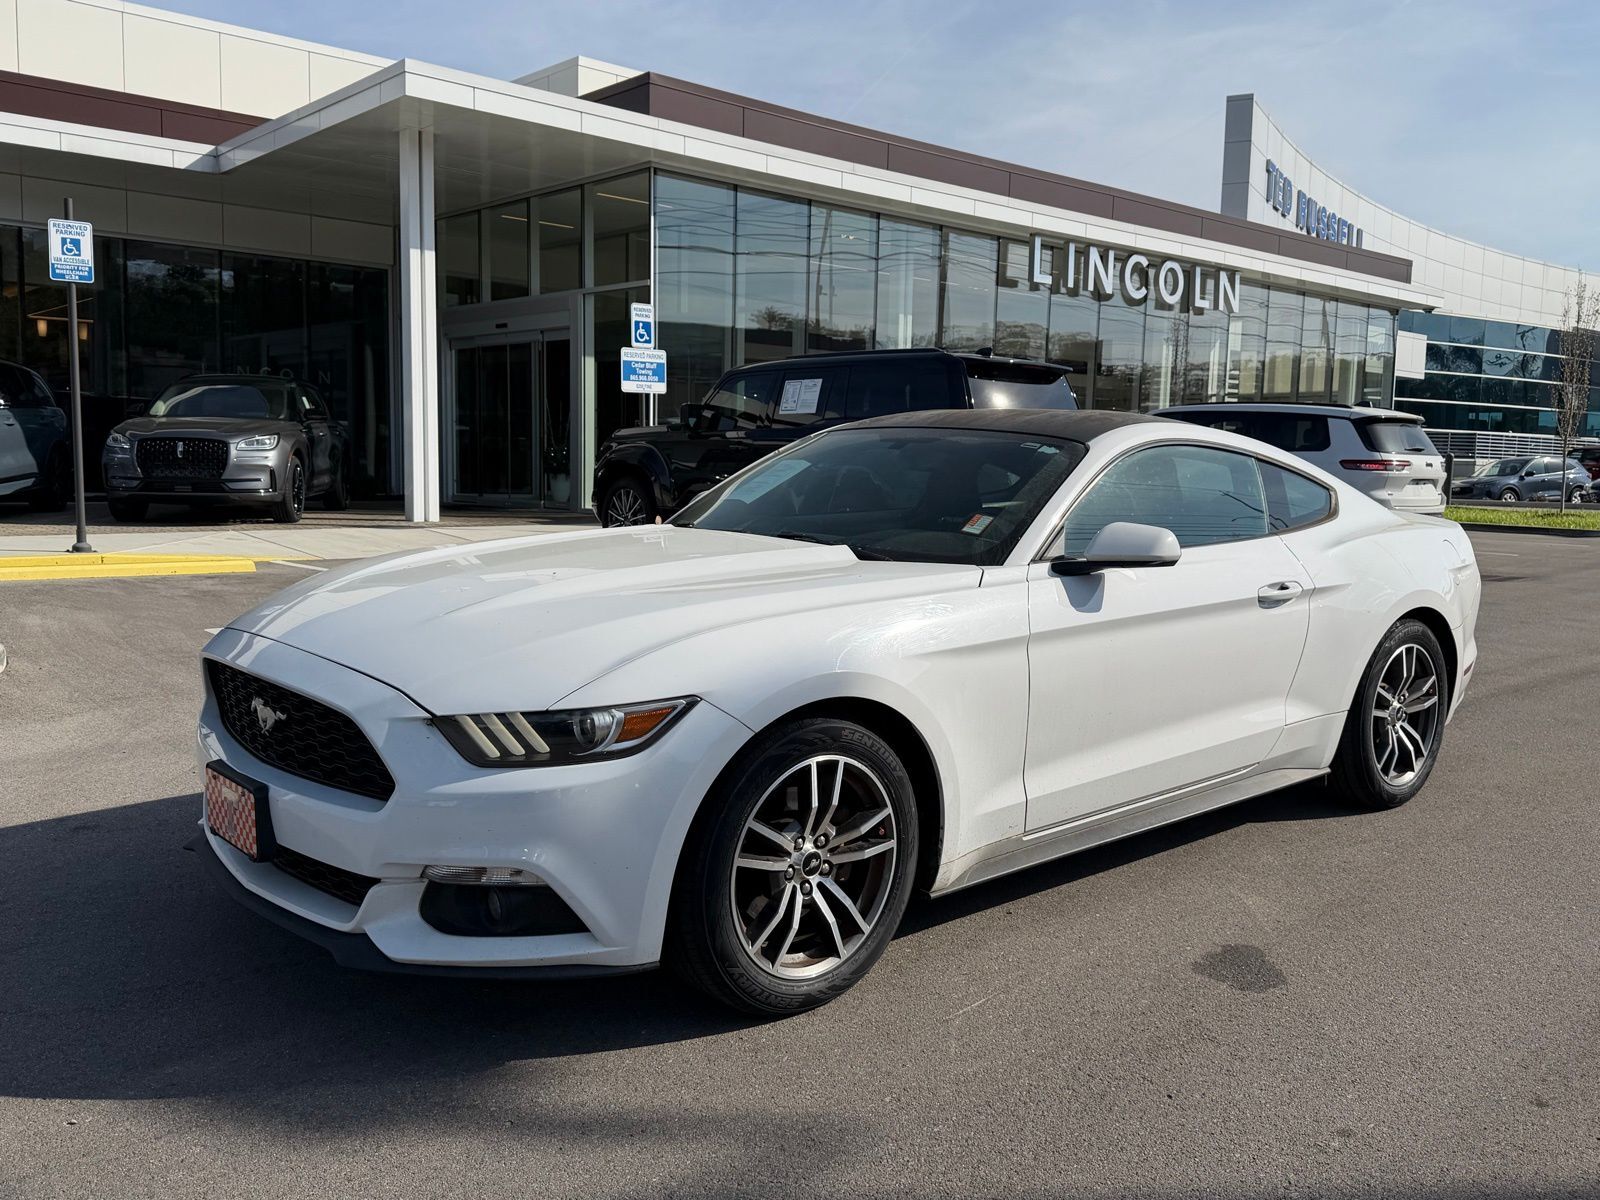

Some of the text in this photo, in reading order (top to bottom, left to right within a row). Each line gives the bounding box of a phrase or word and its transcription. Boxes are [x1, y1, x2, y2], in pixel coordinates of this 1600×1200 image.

[1266, 159, 1293, 218] TED
[52, 222, 88, 231] RESERVED
[55, 229, 85, 237] PARKING
[1033, 235, 1241, 313] LINCOLN
